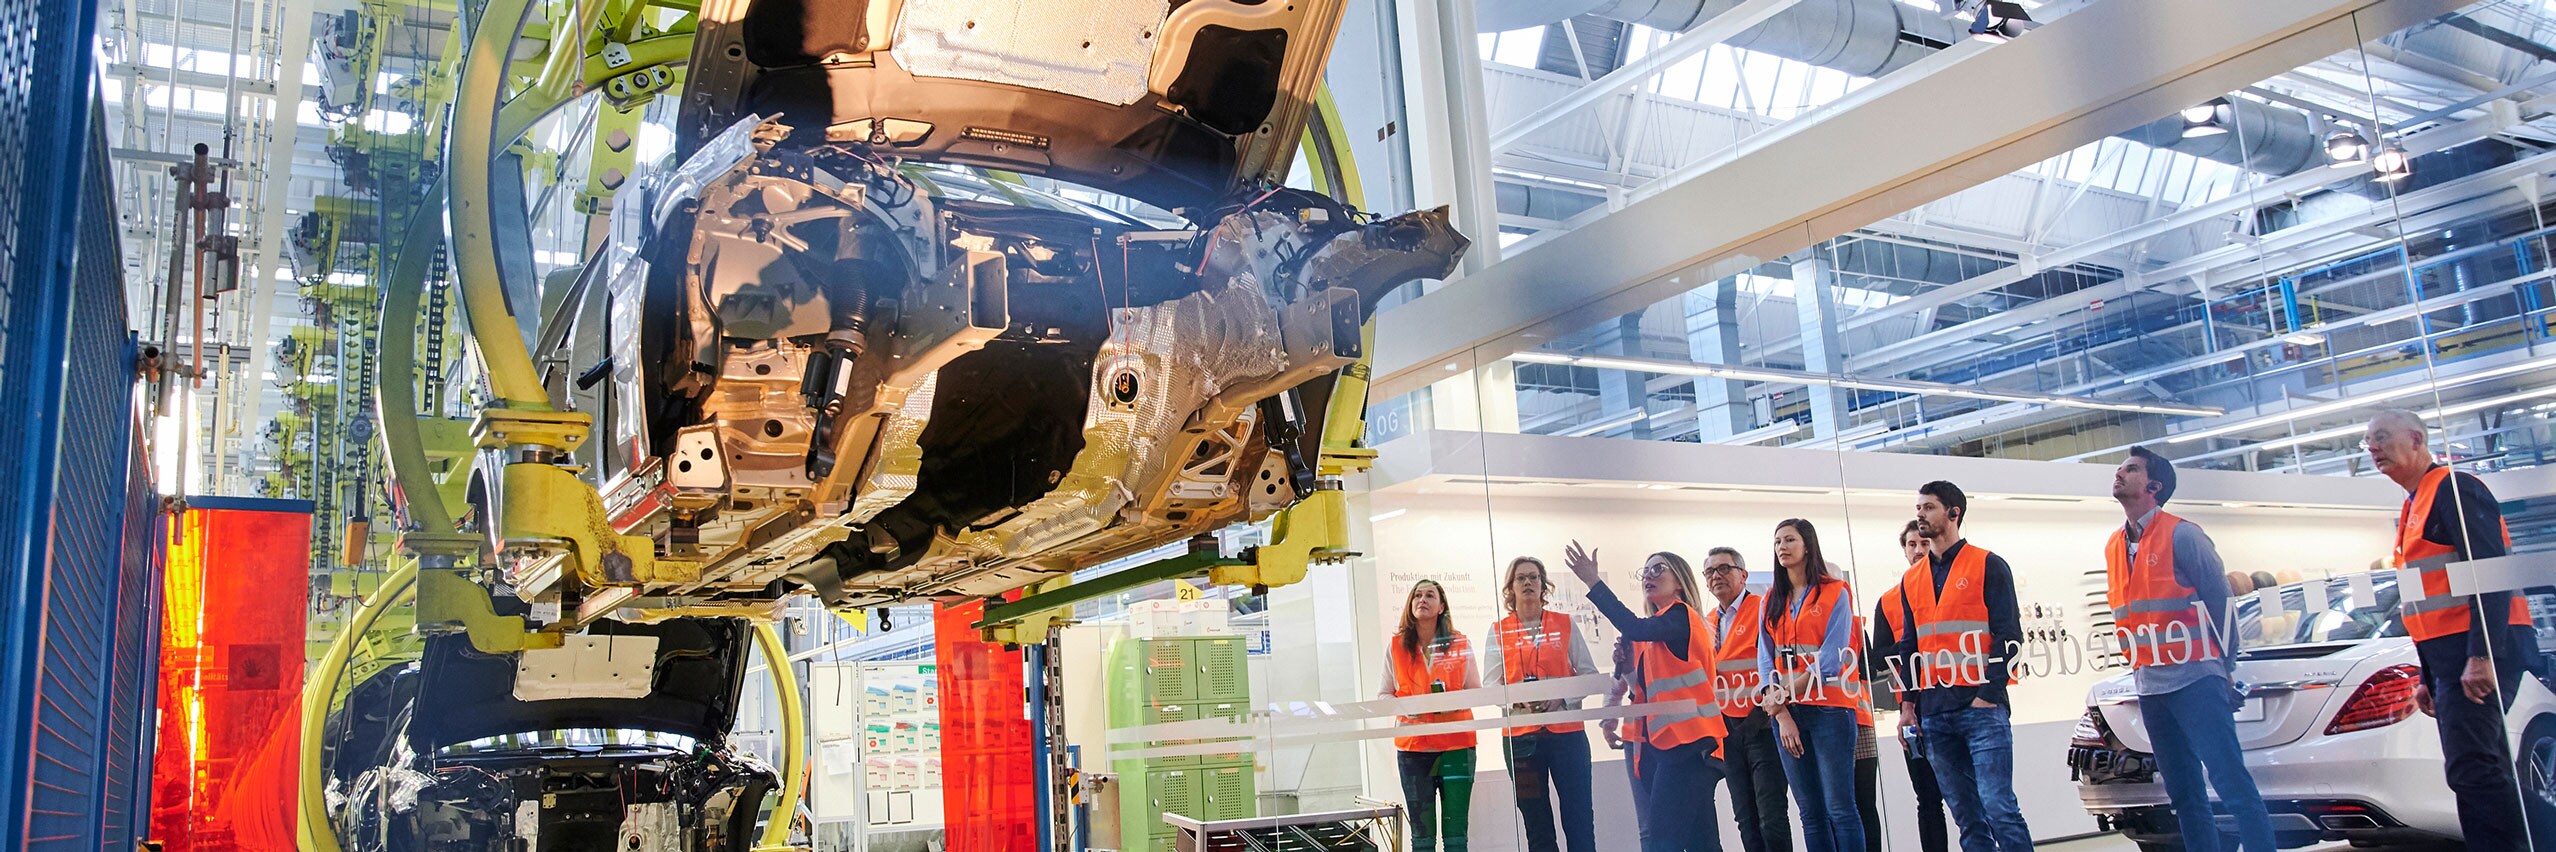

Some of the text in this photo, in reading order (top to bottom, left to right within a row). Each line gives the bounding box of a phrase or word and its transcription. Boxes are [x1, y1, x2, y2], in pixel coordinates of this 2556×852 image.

[1390, 572, 1429, 581] Produktion
[1430, 572, 1442, 581] mit
[1180, 588, 1194, 600] 21
